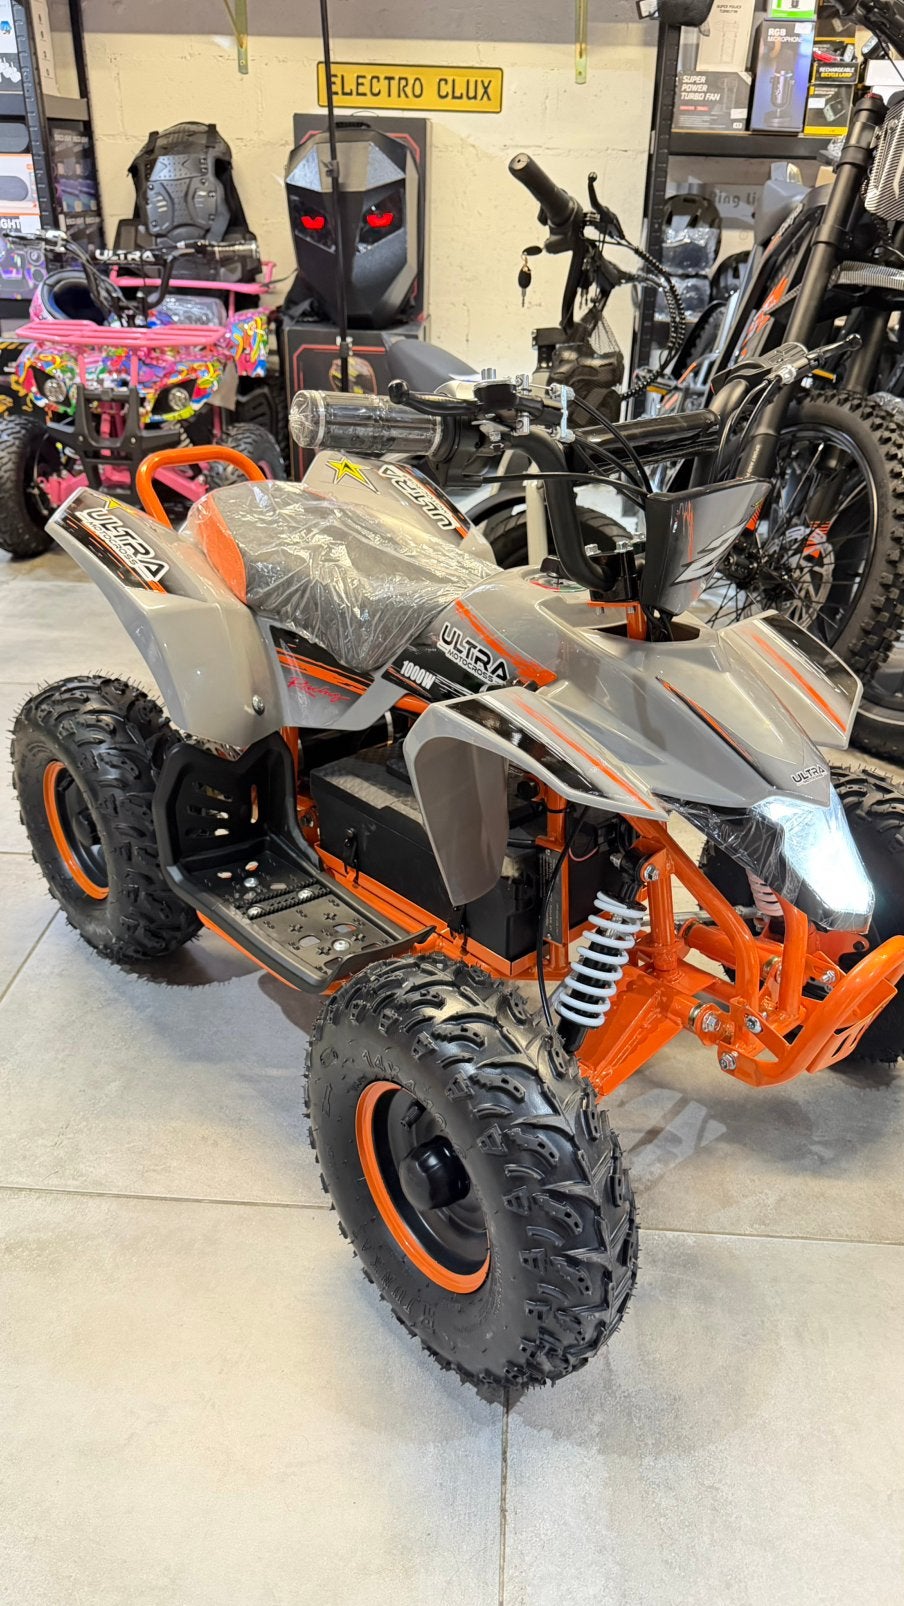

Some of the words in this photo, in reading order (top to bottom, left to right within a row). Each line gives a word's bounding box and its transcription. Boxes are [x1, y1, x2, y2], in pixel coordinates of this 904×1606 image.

[768, 28, 786, 36] RGB
[329, 73, 424, 99] ELECTRO
[437, 77, 493, 102] CLUX
[681, 84, 708, 92] POWER
[682, 75, 706, 83] SUPER
[705, 93, 721, 101] FAN
[0, 219, 20, 229] GHT
[94, 248, 156, 262] ULTRA
[381, 466, 453, 528] ULTRA
[83, 509, 166, 579] ULTRA
[86, 520, 139, 566] MOTOCROSS
[440, 622, 509, 682] ULTRA
[400, 660, 436, 690] 1000W
[446, 649, 494, 683] MOTOCROSS
[791, 765, 826, 783] ULTRA
